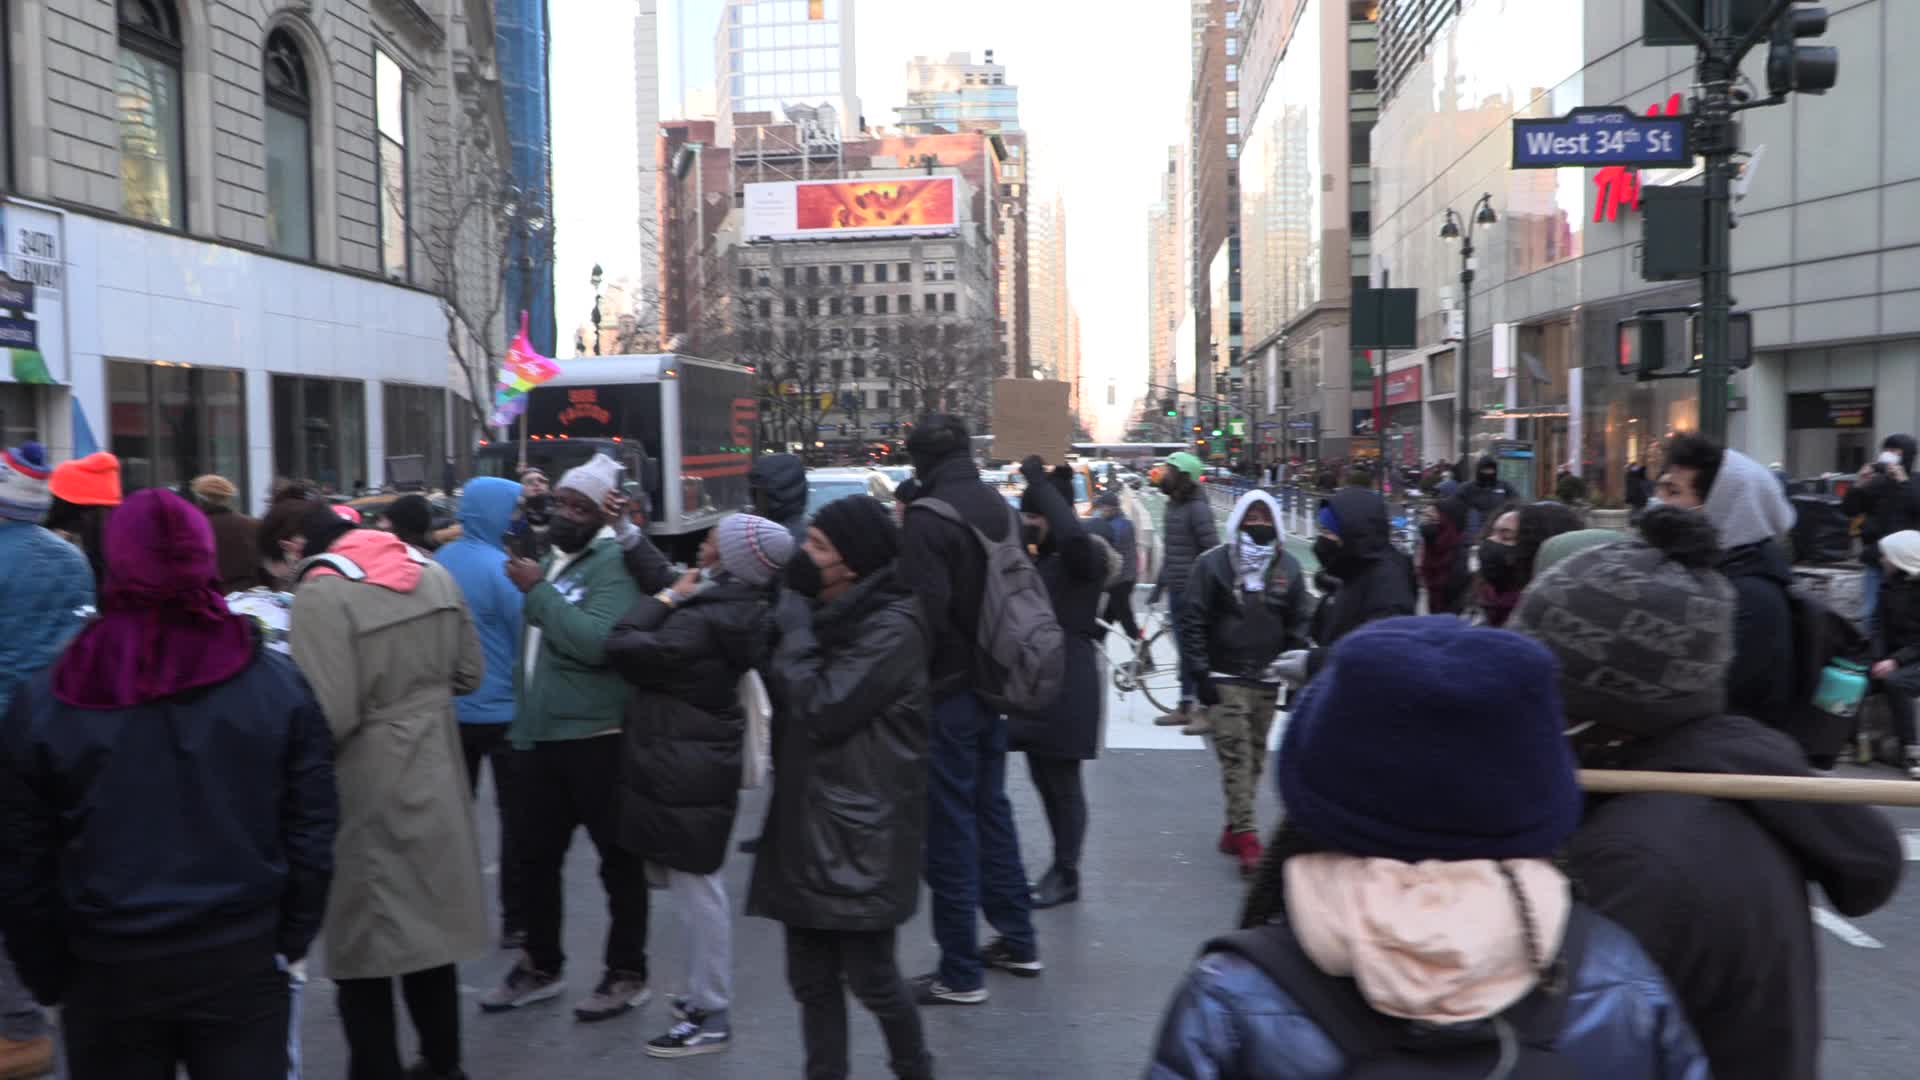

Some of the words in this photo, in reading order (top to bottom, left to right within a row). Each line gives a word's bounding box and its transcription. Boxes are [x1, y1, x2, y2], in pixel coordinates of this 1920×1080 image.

[1526, 131, 1590, 155] West
[1595, 128, 1641, 154] 34th
[1645, 128, 1673, 153] St
